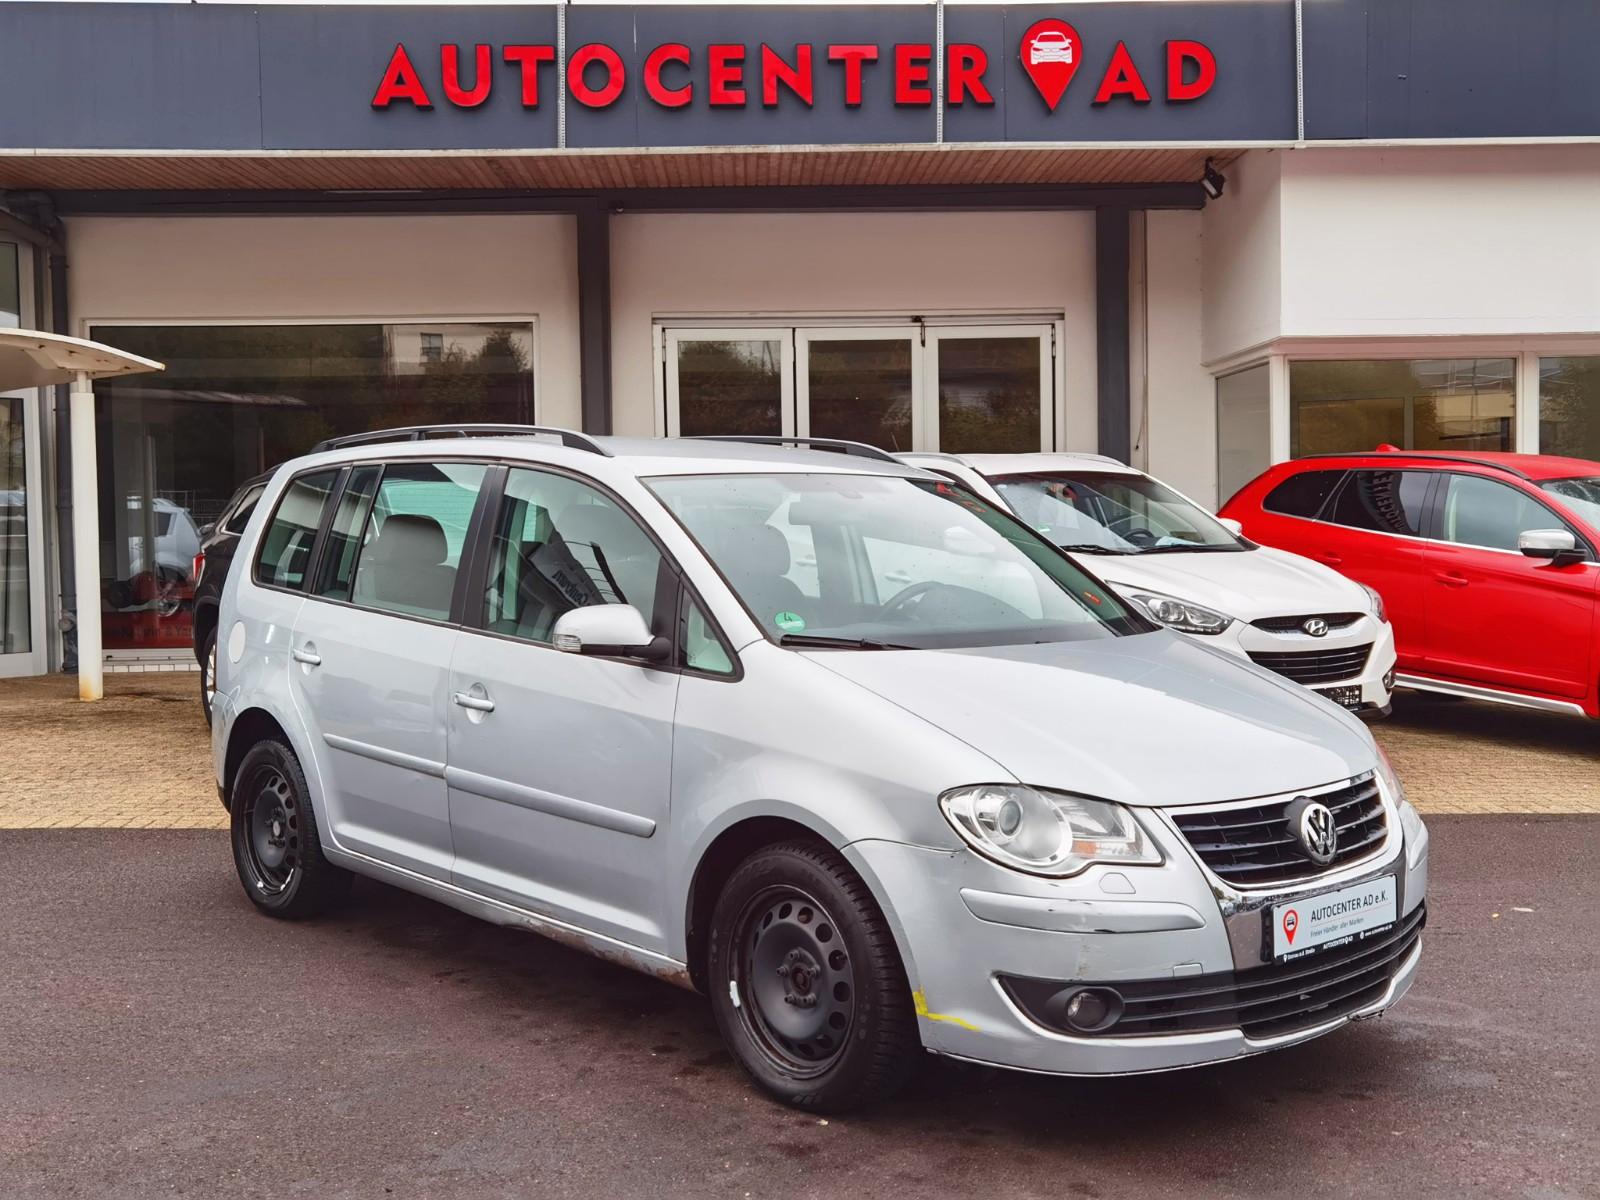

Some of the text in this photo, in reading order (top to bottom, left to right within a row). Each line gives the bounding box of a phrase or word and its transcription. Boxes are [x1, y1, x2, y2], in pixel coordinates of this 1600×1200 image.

[371, 39, 1218, 109] AUTOCENTER AD
[1310, 890, 1389, 922] AUTOCENTER AD e.K.
